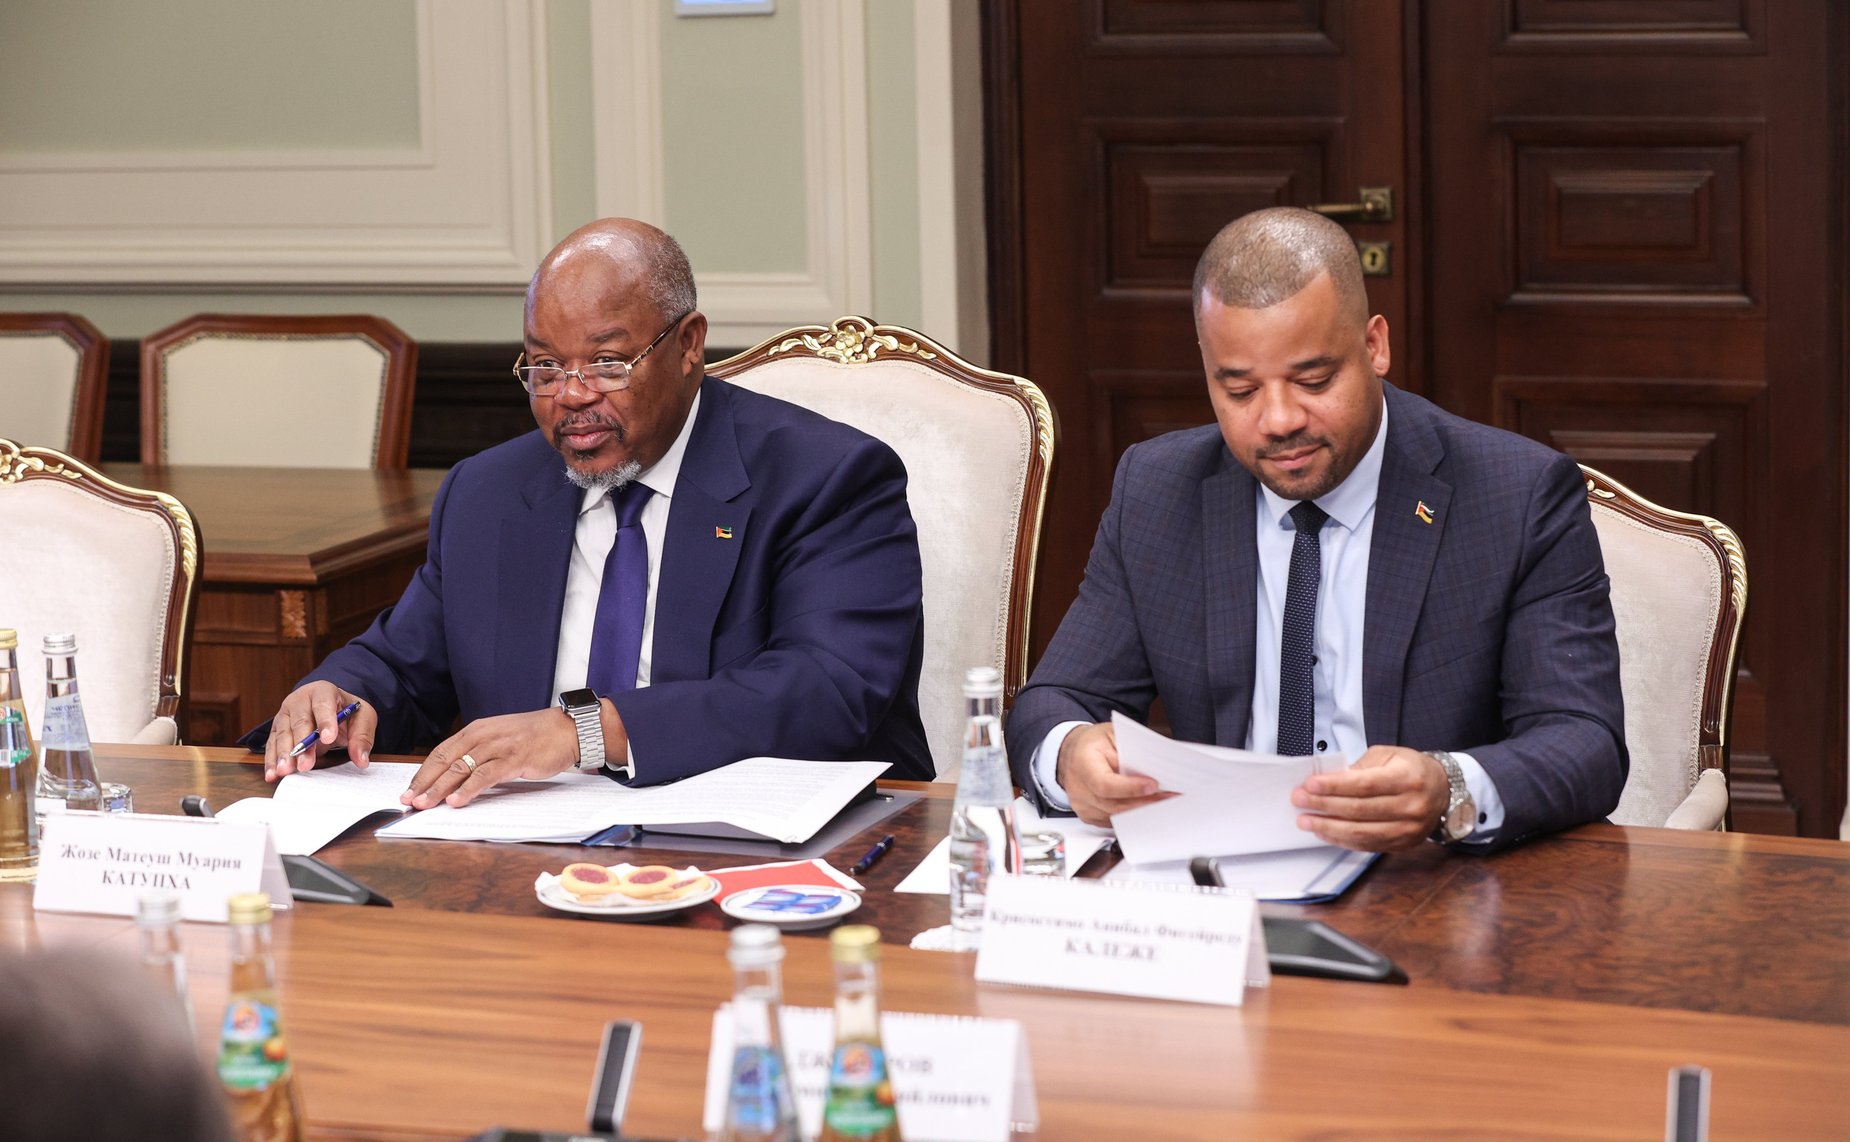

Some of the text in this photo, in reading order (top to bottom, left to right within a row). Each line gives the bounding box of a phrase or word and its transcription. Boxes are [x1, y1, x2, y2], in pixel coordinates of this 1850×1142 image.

[60, 843, 242, 872] Жозе Матеуш Муария
[102, 869, 192, 890] КАТУПХА
